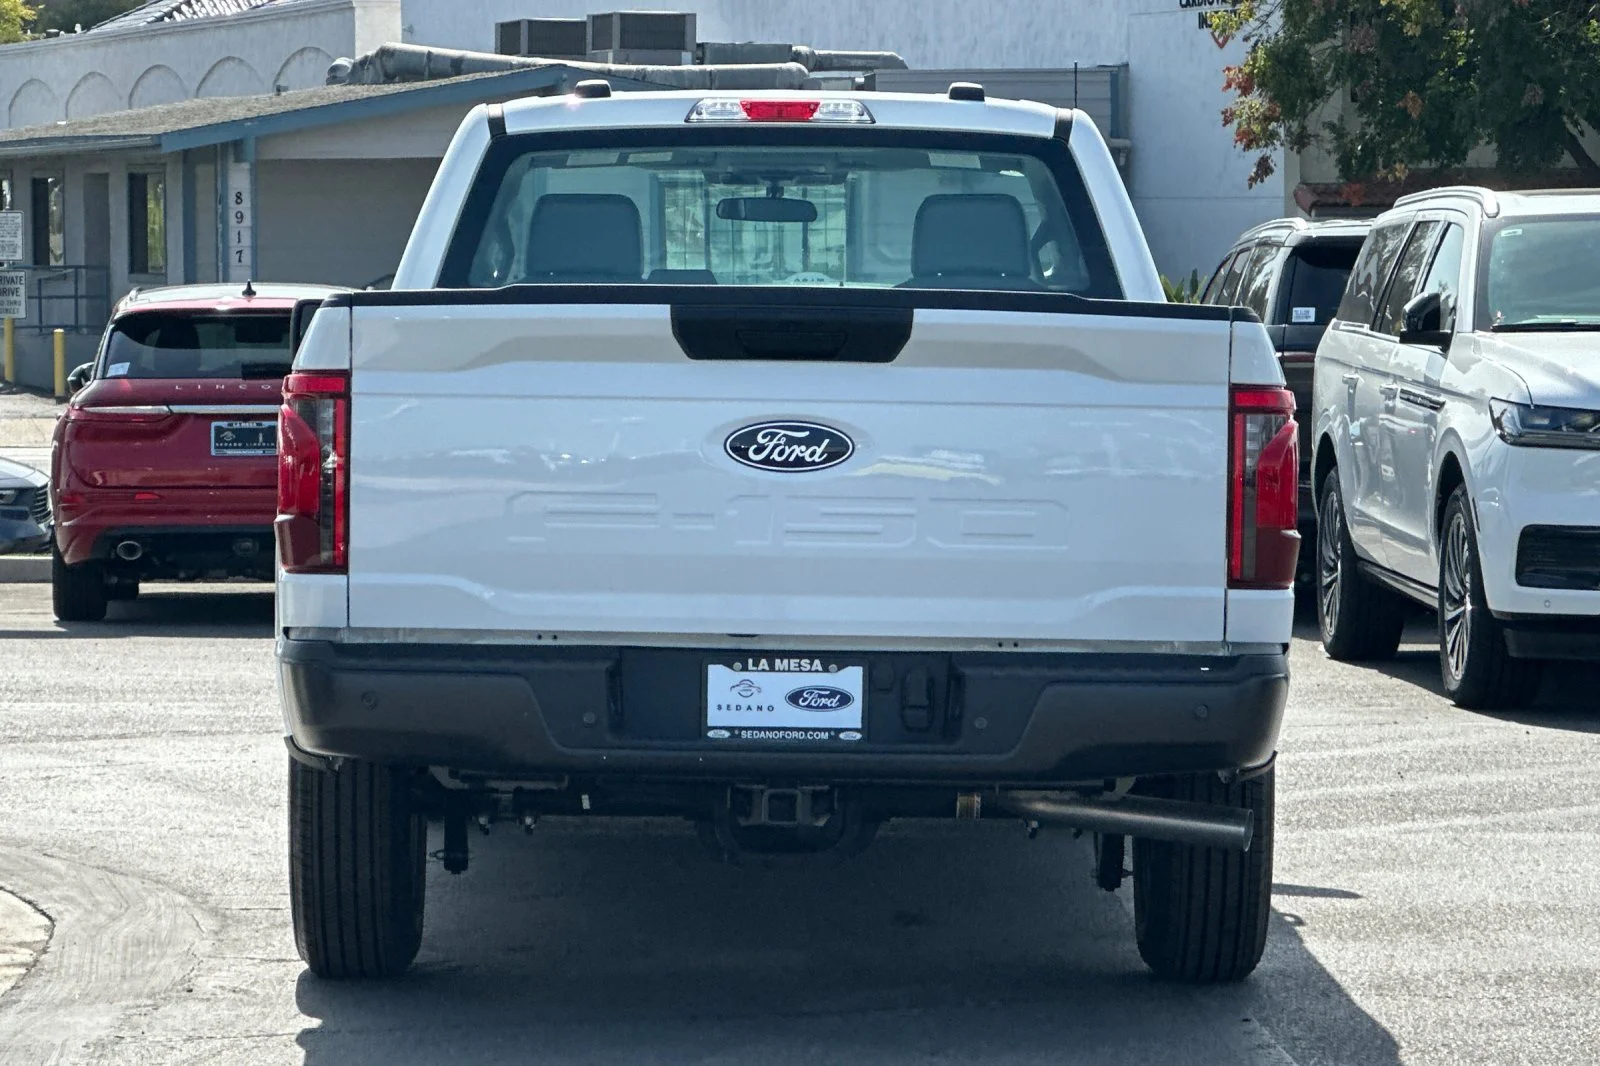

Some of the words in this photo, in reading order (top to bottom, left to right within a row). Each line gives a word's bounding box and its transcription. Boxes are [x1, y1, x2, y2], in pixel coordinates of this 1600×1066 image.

[235, 191, 244, 263] 8917
[0, 276, 24, 285] RIVATE
[748, 428, 830, 463] Ford
[505, 492, 1069, 549] F-150
[747, 658, 770, 671] LA
[774, 658, 823, 672] MESA
[799, 689, 841, 707] Ford
[717, 704, 775, 712] SEDANO
[741, 730, 829, 740] SEDANOFORD.COM
